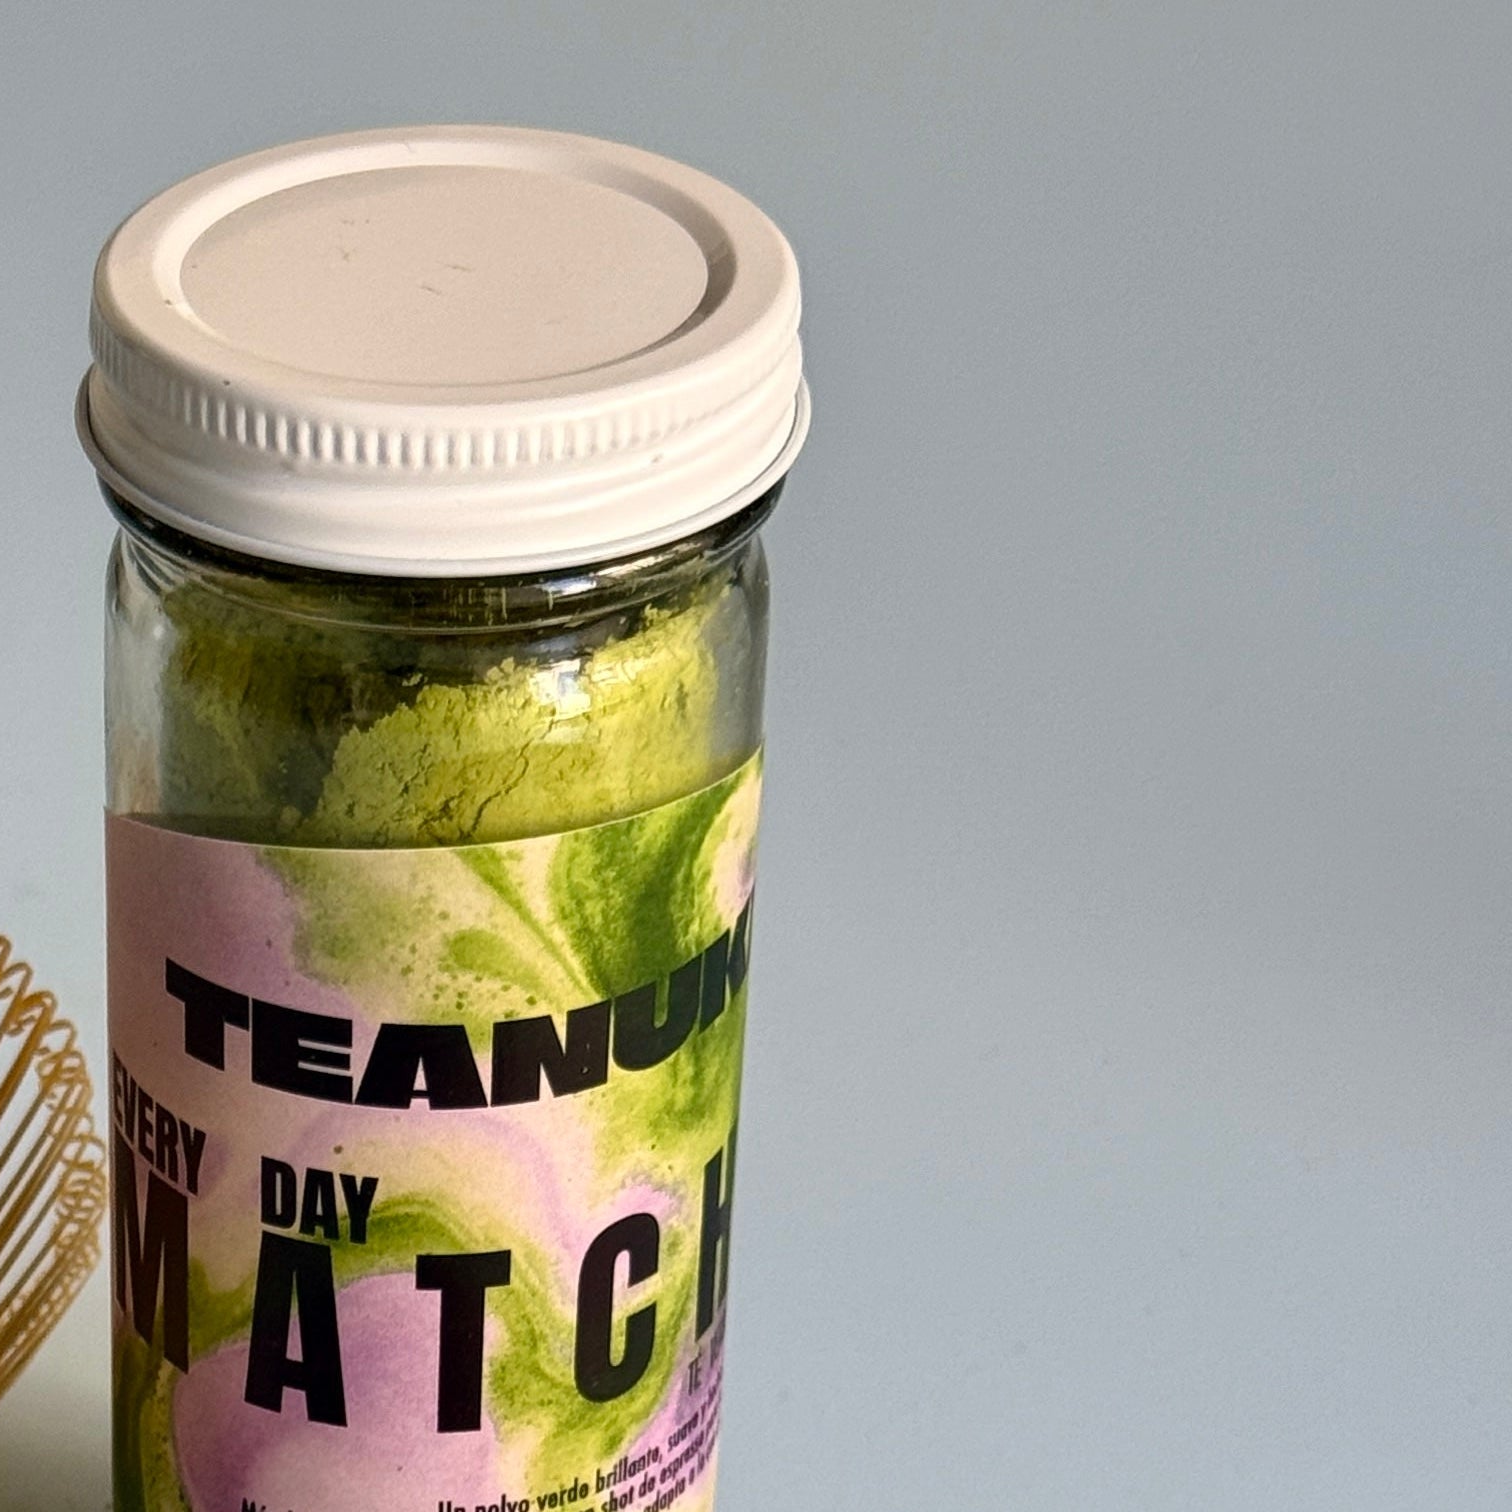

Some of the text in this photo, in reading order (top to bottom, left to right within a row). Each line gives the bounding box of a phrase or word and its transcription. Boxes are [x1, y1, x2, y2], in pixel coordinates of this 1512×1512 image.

[165, 888, 754, 1110] TEANUK
[113, 1048, 379, 1245] EVERY DAY
[537, 1477, 588, 1512] verde
[595, 1446, 662, 1494] brillante,
[668, 1412, 698, 1451] suave
[638, 1472, 656, 1498] de
